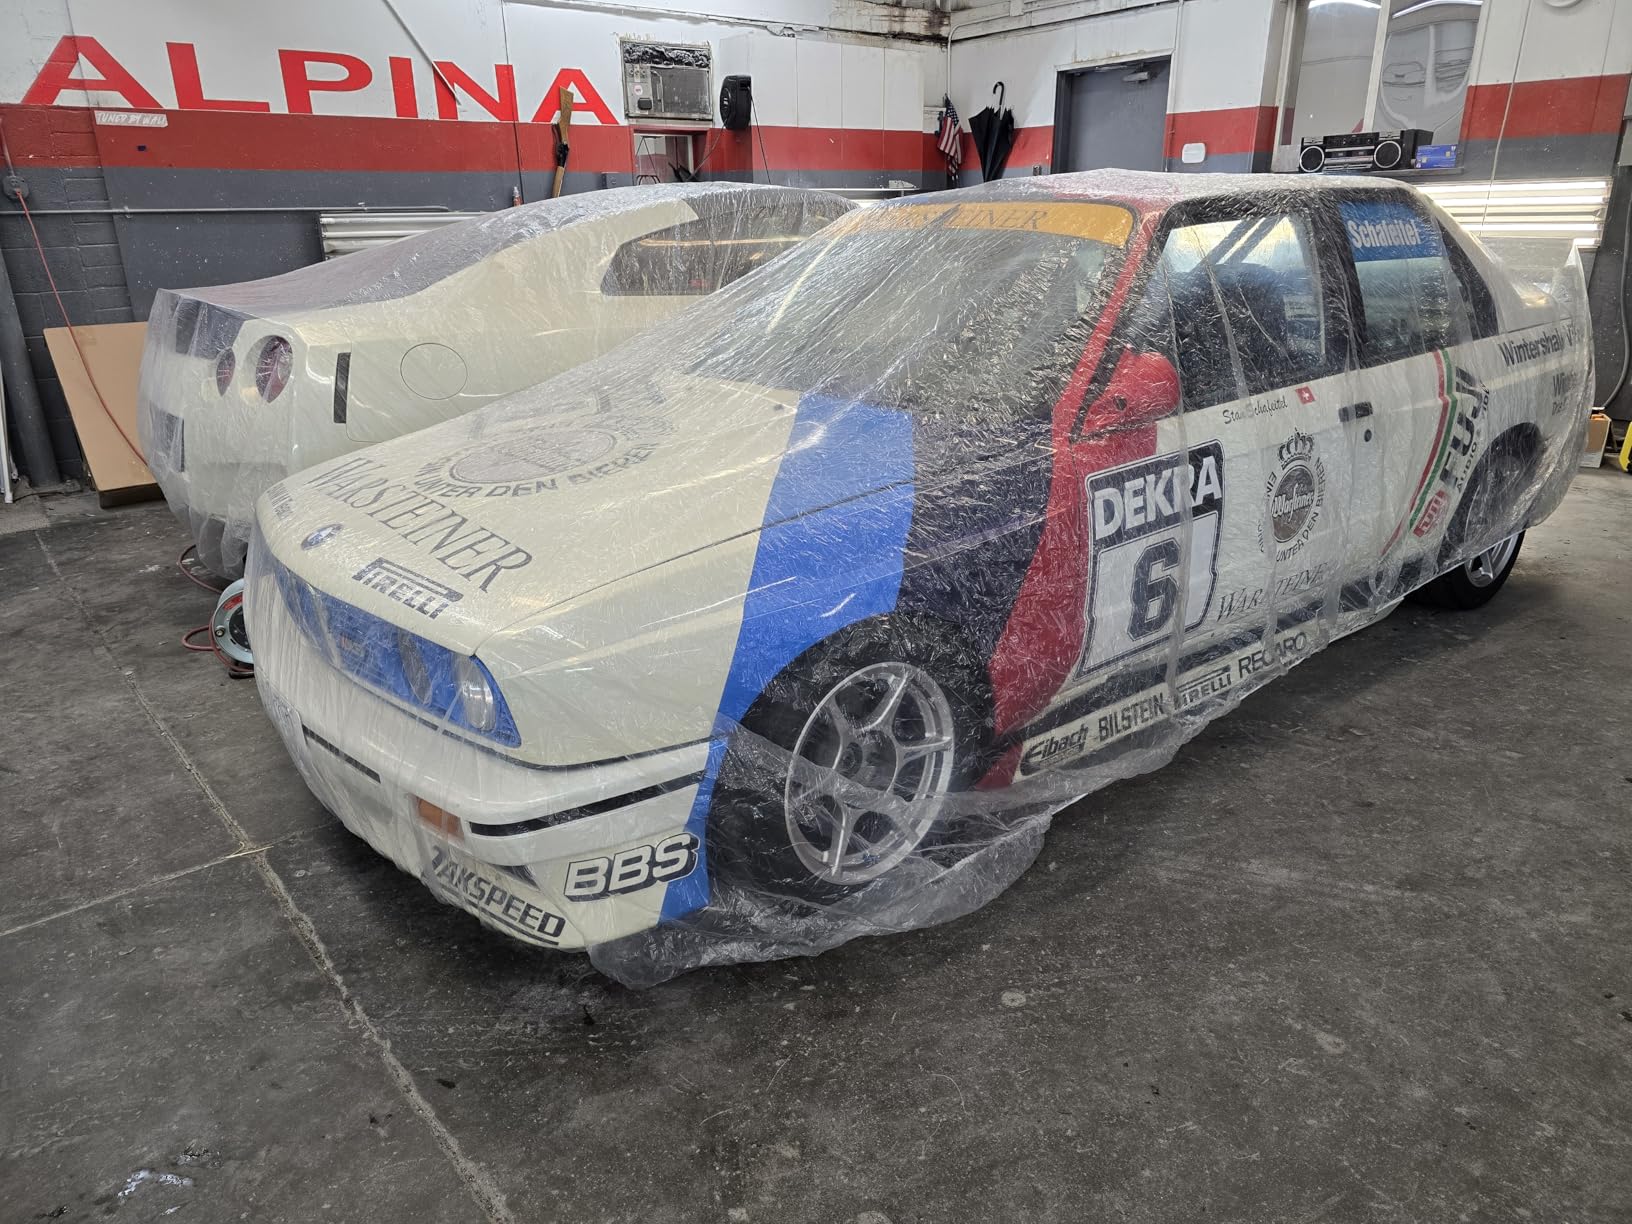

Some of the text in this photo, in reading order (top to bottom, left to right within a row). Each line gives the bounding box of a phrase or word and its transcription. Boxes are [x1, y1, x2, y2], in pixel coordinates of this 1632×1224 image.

[20, 35, 619, 125] ALPINA
[485, 478, 558, 498] DEN
[1095, 456, 1223, 540] DEKRA
[303, 457, 533, 594] WARSTEINER
[1302, 512, 1318, 541] DEN
[351, 557, 465, 620] PIRELLI
[1126, 537, 1182, 642] 6
[1098, 693, 1165, 740] BILSTEIN
[563, 832, 700, 902] BBS
